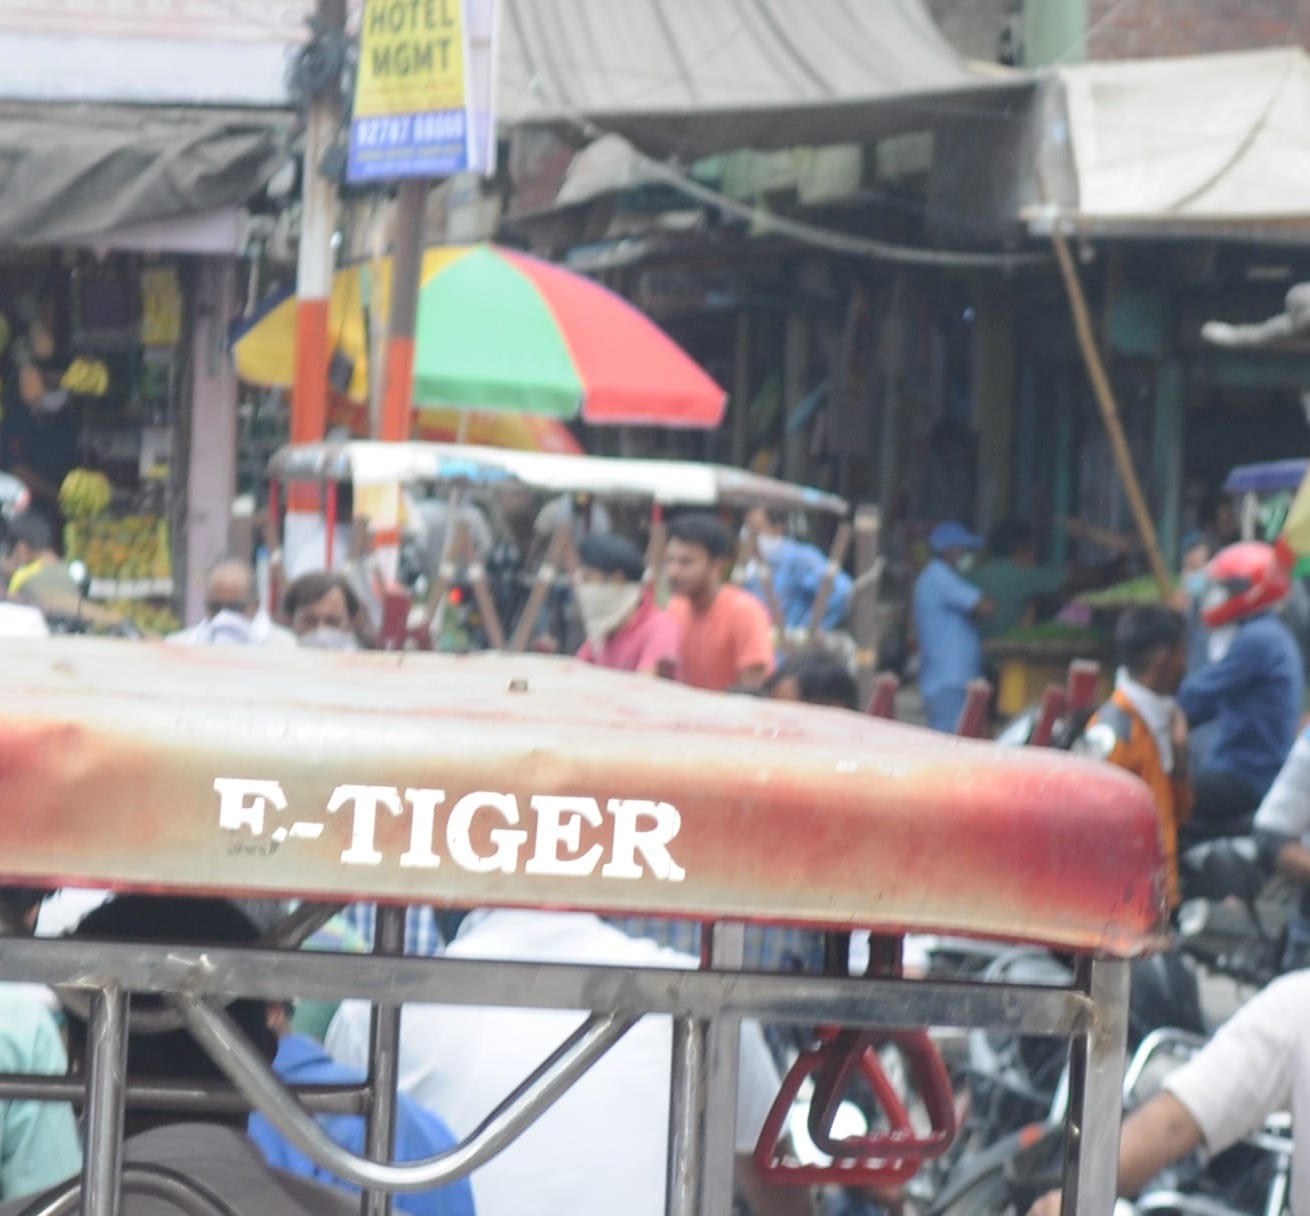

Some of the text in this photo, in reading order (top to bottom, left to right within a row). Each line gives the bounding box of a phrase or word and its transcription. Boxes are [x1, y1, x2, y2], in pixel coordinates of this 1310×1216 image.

[370, 0, 453, 34] HOTEL
[370, 40, 451, 77] MGMT
[214, 778, 685, 882] E-TIGER
